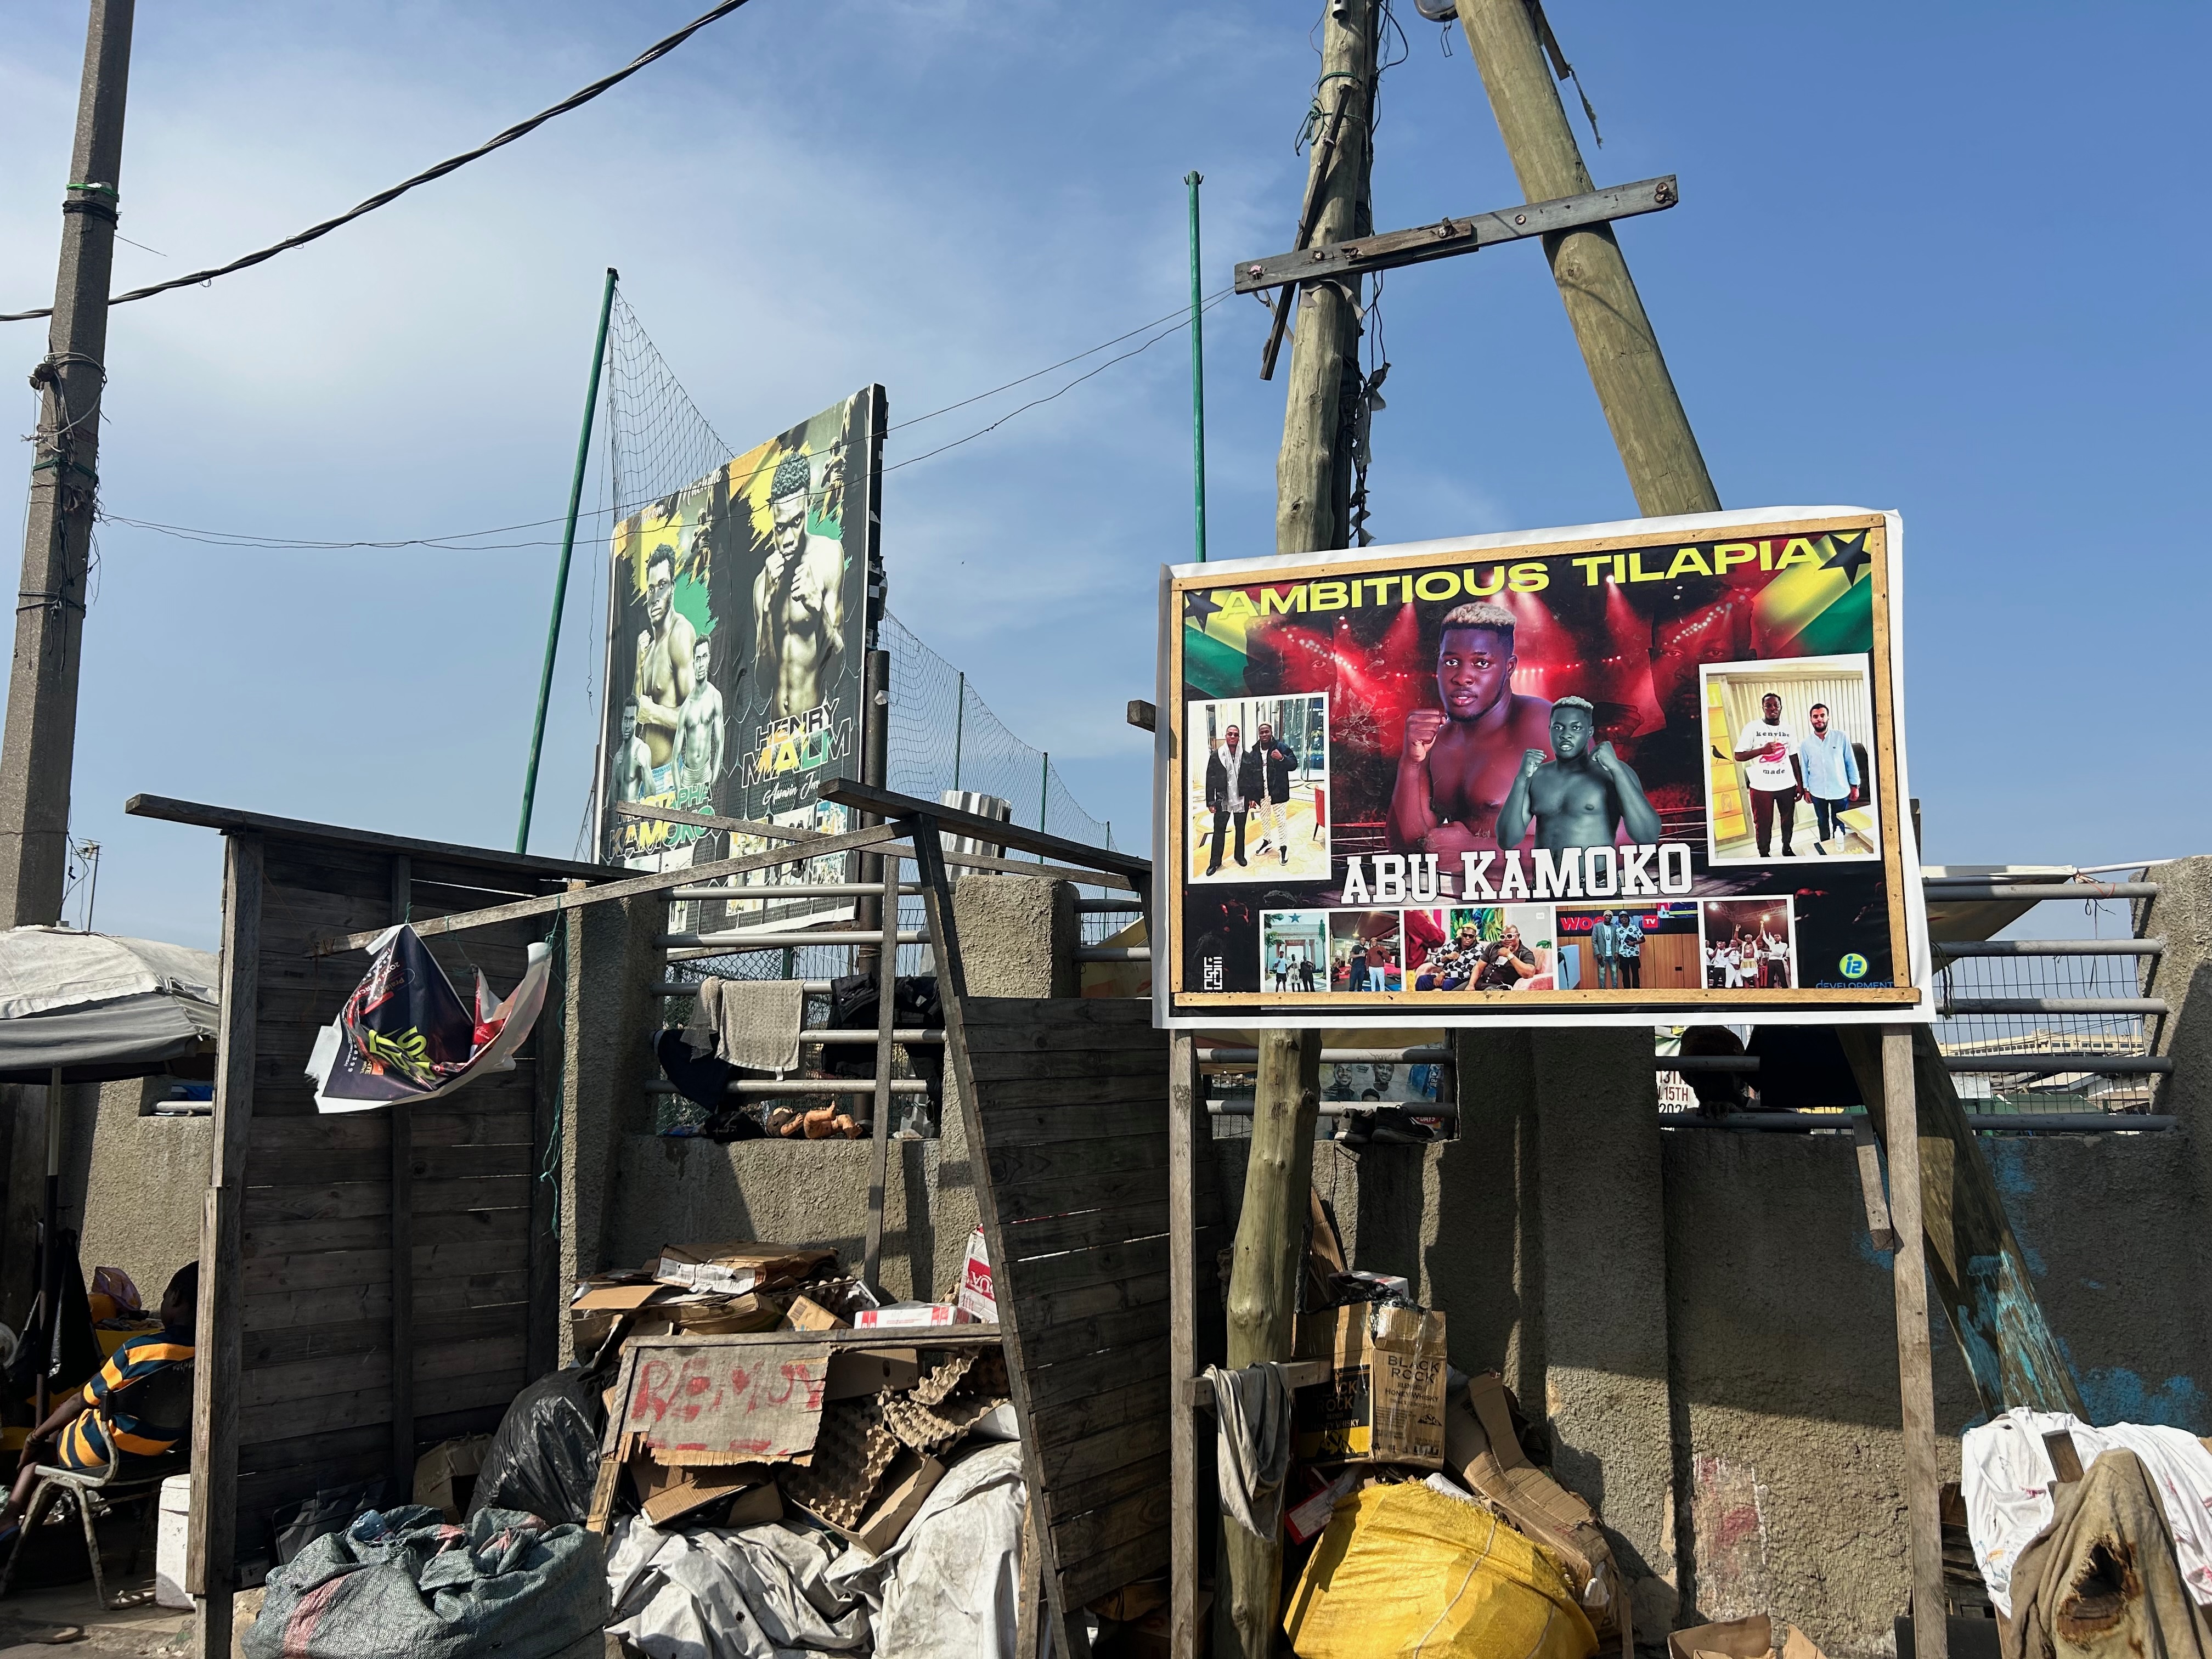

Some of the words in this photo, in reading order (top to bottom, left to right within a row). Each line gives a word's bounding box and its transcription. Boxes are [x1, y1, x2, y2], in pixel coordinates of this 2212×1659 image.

[1217, 562, 1550, 620] AMBITIOUS
[1572, 538, 1822, 587] TILAPIA
[755, 697, 840, 751] HENRY
[741, 717, 851, 789] MALM
[1340, 853, 1438, 905] ABU
[1461, 843, 1691, 901] KAMOKO
[1664, 1087, 1689, 1102] 15TH
[1388, 1355, 1440, 1373] BLACK
[1391, 1367, 1436, 1384] ROCK
[1412, 1392, 1440, 1403] WHISKY
